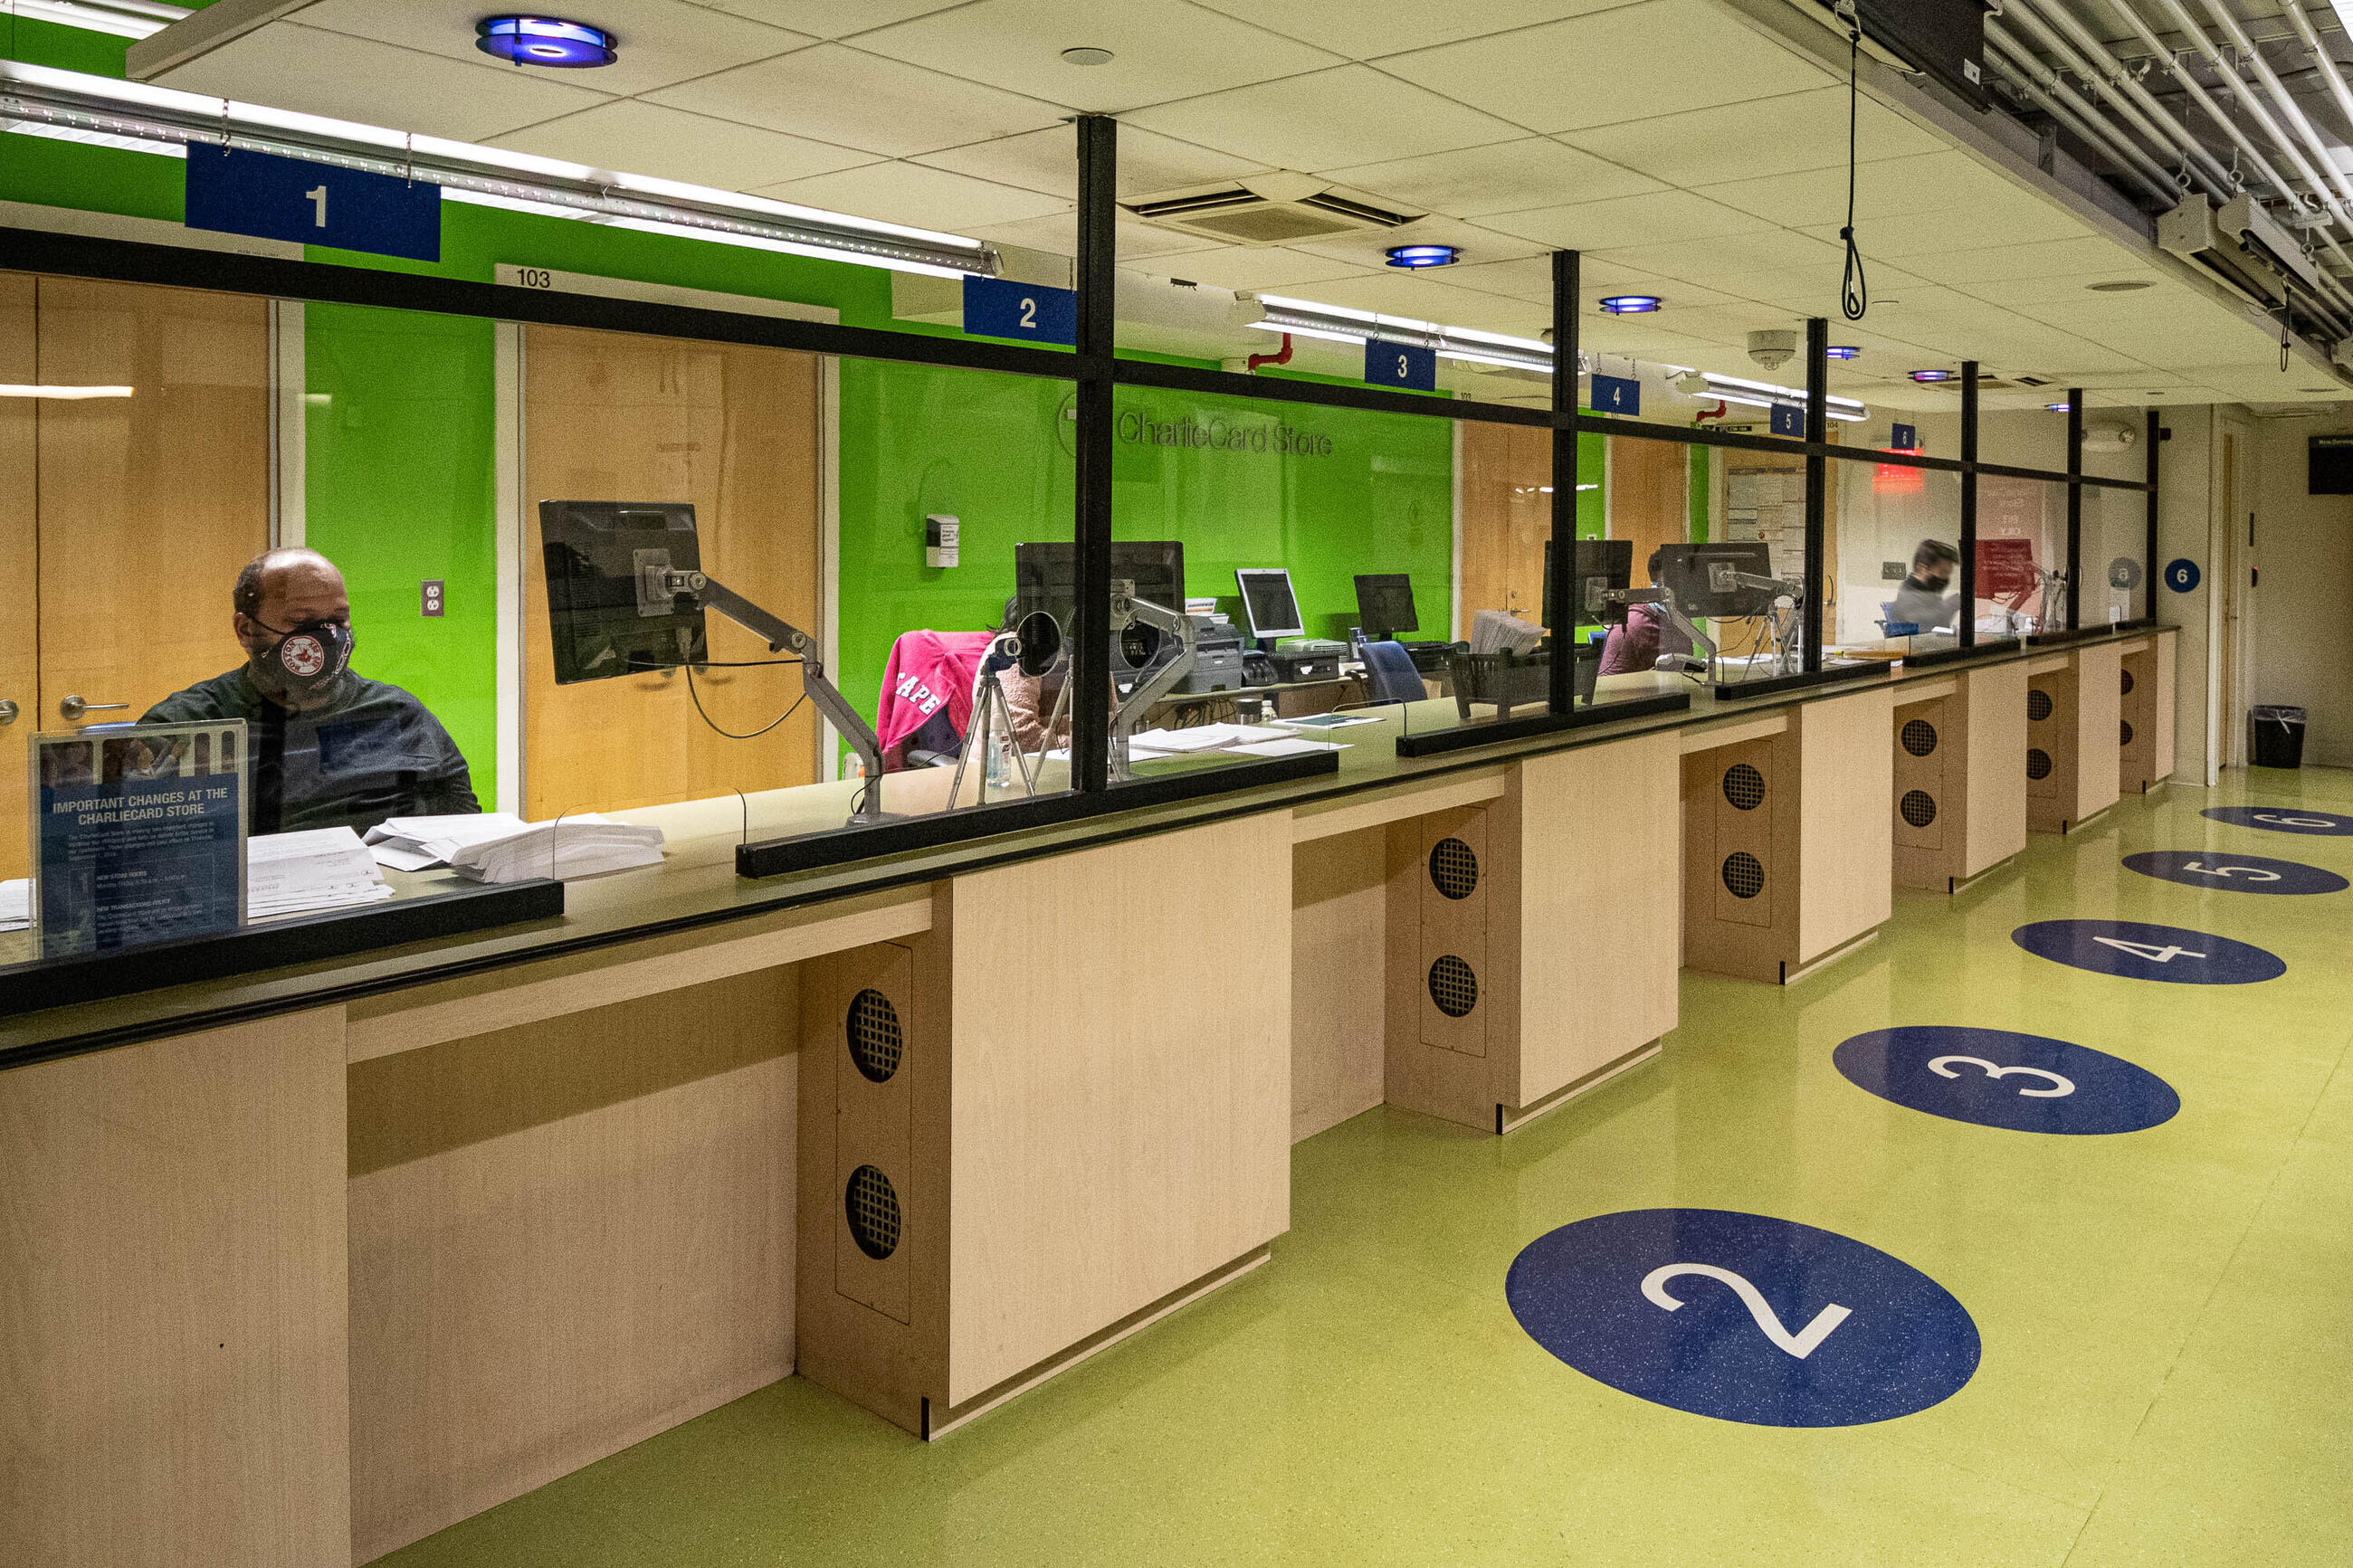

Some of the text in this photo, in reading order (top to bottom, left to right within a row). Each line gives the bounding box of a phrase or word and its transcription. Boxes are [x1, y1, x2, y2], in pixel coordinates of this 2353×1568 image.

[305, 185, 327, 228] 1
[517, 268, 550, 289] 103
[1019, 298, 1036, 328] 2
[1397, 354, 1407, 378] 3
[1613, 386, 1621, 406] 4
[1117, 411, 1333, 455] CharlieCard Store
[1786, 413, 1792, 430] 5
[1902, 431, 1908, 445] 6
[2177, 568, 2188, 584] 6
[284, 640, 300, 671] BOSTON
[896, 672, 941, 716] APE
[52, 787, 228, 813] IMPORTANT CHANGES AT THE
[78, 803, 205, 825] CHARLIECARD STORE
[2253, 813, 2336, 829] 6
[2182, 860, 2282, 882] 5
[2092, 935, 2207, 963] 4
[1927, 1054, 2075, 1098] 3
[1640, 1262, 1853, 1360] 2
